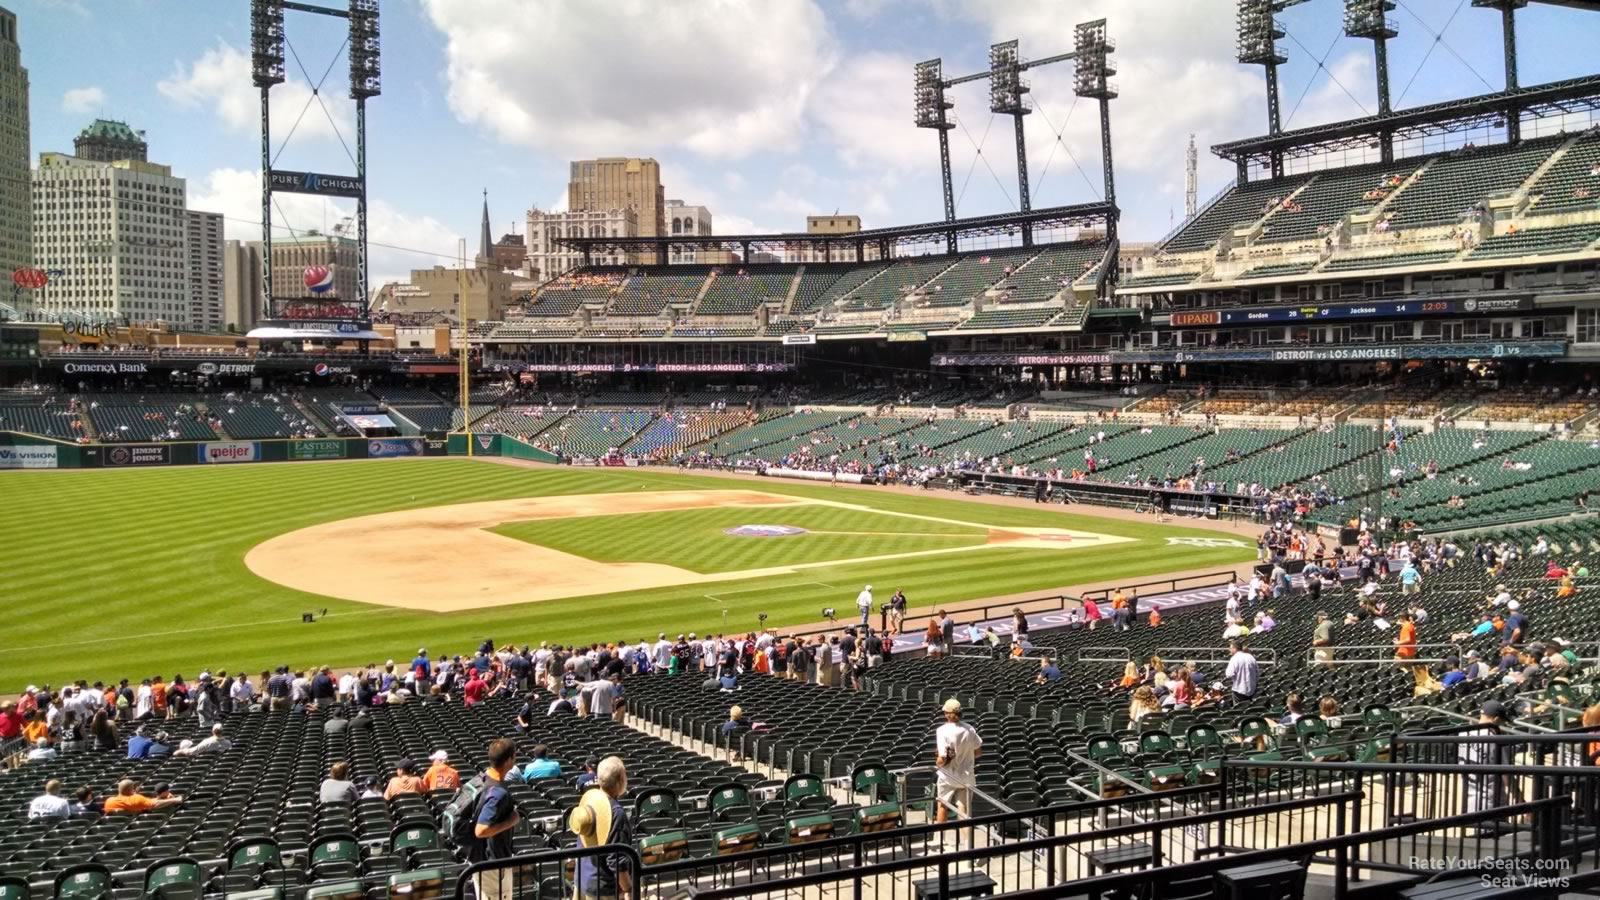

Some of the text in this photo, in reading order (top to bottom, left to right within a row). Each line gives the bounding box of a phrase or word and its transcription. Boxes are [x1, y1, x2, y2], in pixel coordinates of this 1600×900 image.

[272, 171, 363, 191] PURE MICHIGAN
[14, 268, 47, 288] AAA
[1421, 302, 1448, 311] 12:03
[1478, 299, 1520, 307] DETROIT
[1350, 306, 1376, 314] Jackson
[1176, 313, 1213, 325] LIPARI
[303, 322, 338, 330] AMSTERDAM
[1276, 350, 1314, 360] DETROIT
[1329, 349, 1348, 359] LOS
[1351, 348, 1397, 359] ANGELES
[1018, 356, 1048, 364] DETROIT
[1059, 356, 1074, 364] LOS
[1076, 355, 1110, 363] ANGELES
[119, 362, 148, 373] Bank
[219, 364, 256, 373] DETROIT
[328, 366, 351, 374] pepsi
[530, 364, 558, 372] DETROIT
[568, 364, 581, 372] LOS
[659, 364, 688, 372] DETROIT
[295, 440, 340, 451] EASTERN
[132, 447, 163, 456] JIMMY
[210, 444, 249, 459] meijer
[132, 454, 163, 463] JOHN'S
[679, 648, 690, 659] 35
